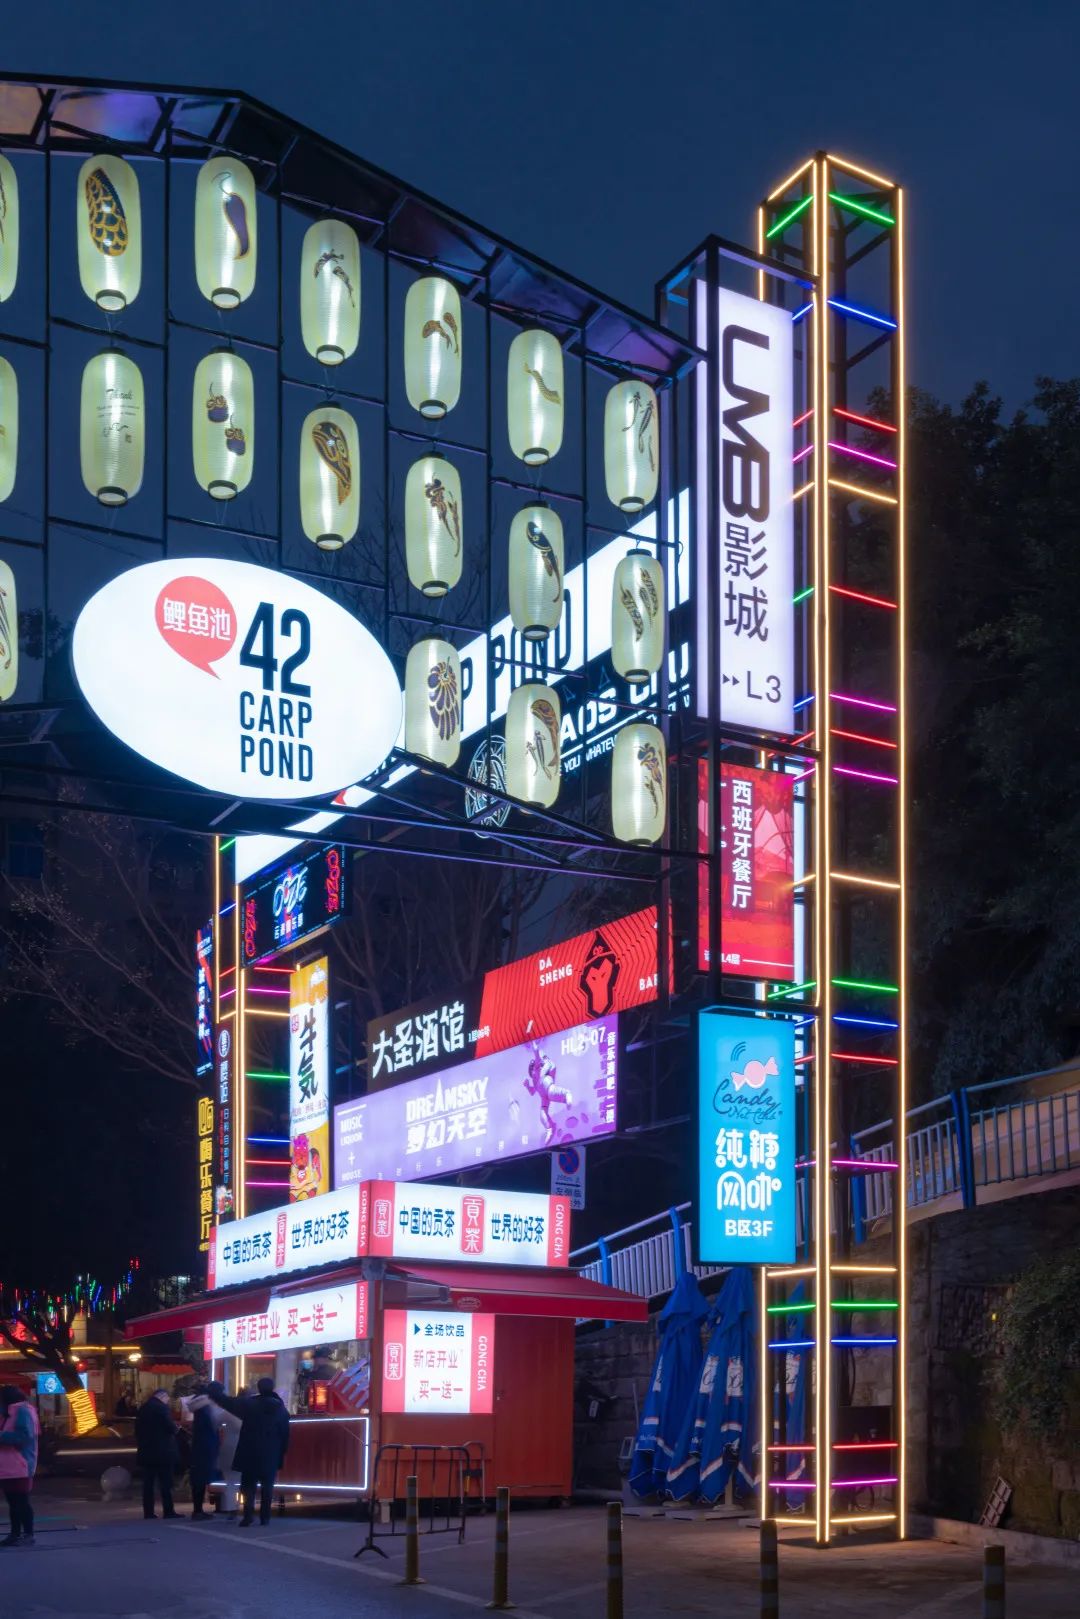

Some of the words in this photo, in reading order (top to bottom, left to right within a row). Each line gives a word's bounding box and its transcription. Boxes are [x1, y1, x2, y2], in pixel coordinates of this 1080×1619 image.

[724, 522, 769, 642] 影城
[239, 601, 311, 698] 42
[746, 670, 782, 704] L3
[239, 690, 313, 739] CARP
[240, 734, 313, 782] POND
[731, 779, 753, 909] 西班牙餐厅
[539, 957, 552, 971] DA
[539, 963, 573, 987] SHENG
[405, 1077, 489, 1123] DREAMSKY
[713, 1079, 781, 1116] Candy
[340, 1113, 363, 1133] MUSIC
[715, 1127, 780, 1171] 纯糖
[716, 1170, 783, 1212] 网咖
[399, 1205, 455, 1238] 中国的贡茶
[491, 1213, 545, 1244] 世界的好茶
[555, 1203, 565, 1234] GONG
[724, 1219, 774, 1238] B区3F
[223, 1230, 272, 1268] 中国的贡茶
[291, 1209, 350, 1250] 世界的好茶
[554, 1235, 564, 1259] CHA
[236, 1311, 281, 1345] 新店开业
[287, 1302, 338, 1336] 买一送一
[424, 1323, 465, 1337] 全场饮品
[413, 1349, 458, 1368] 新店开业
[478, 1335, 488, 1367] GONG
[419, 1380, 464, 1399] 买一送一
[477, 1369, 487, 1391] CHA
